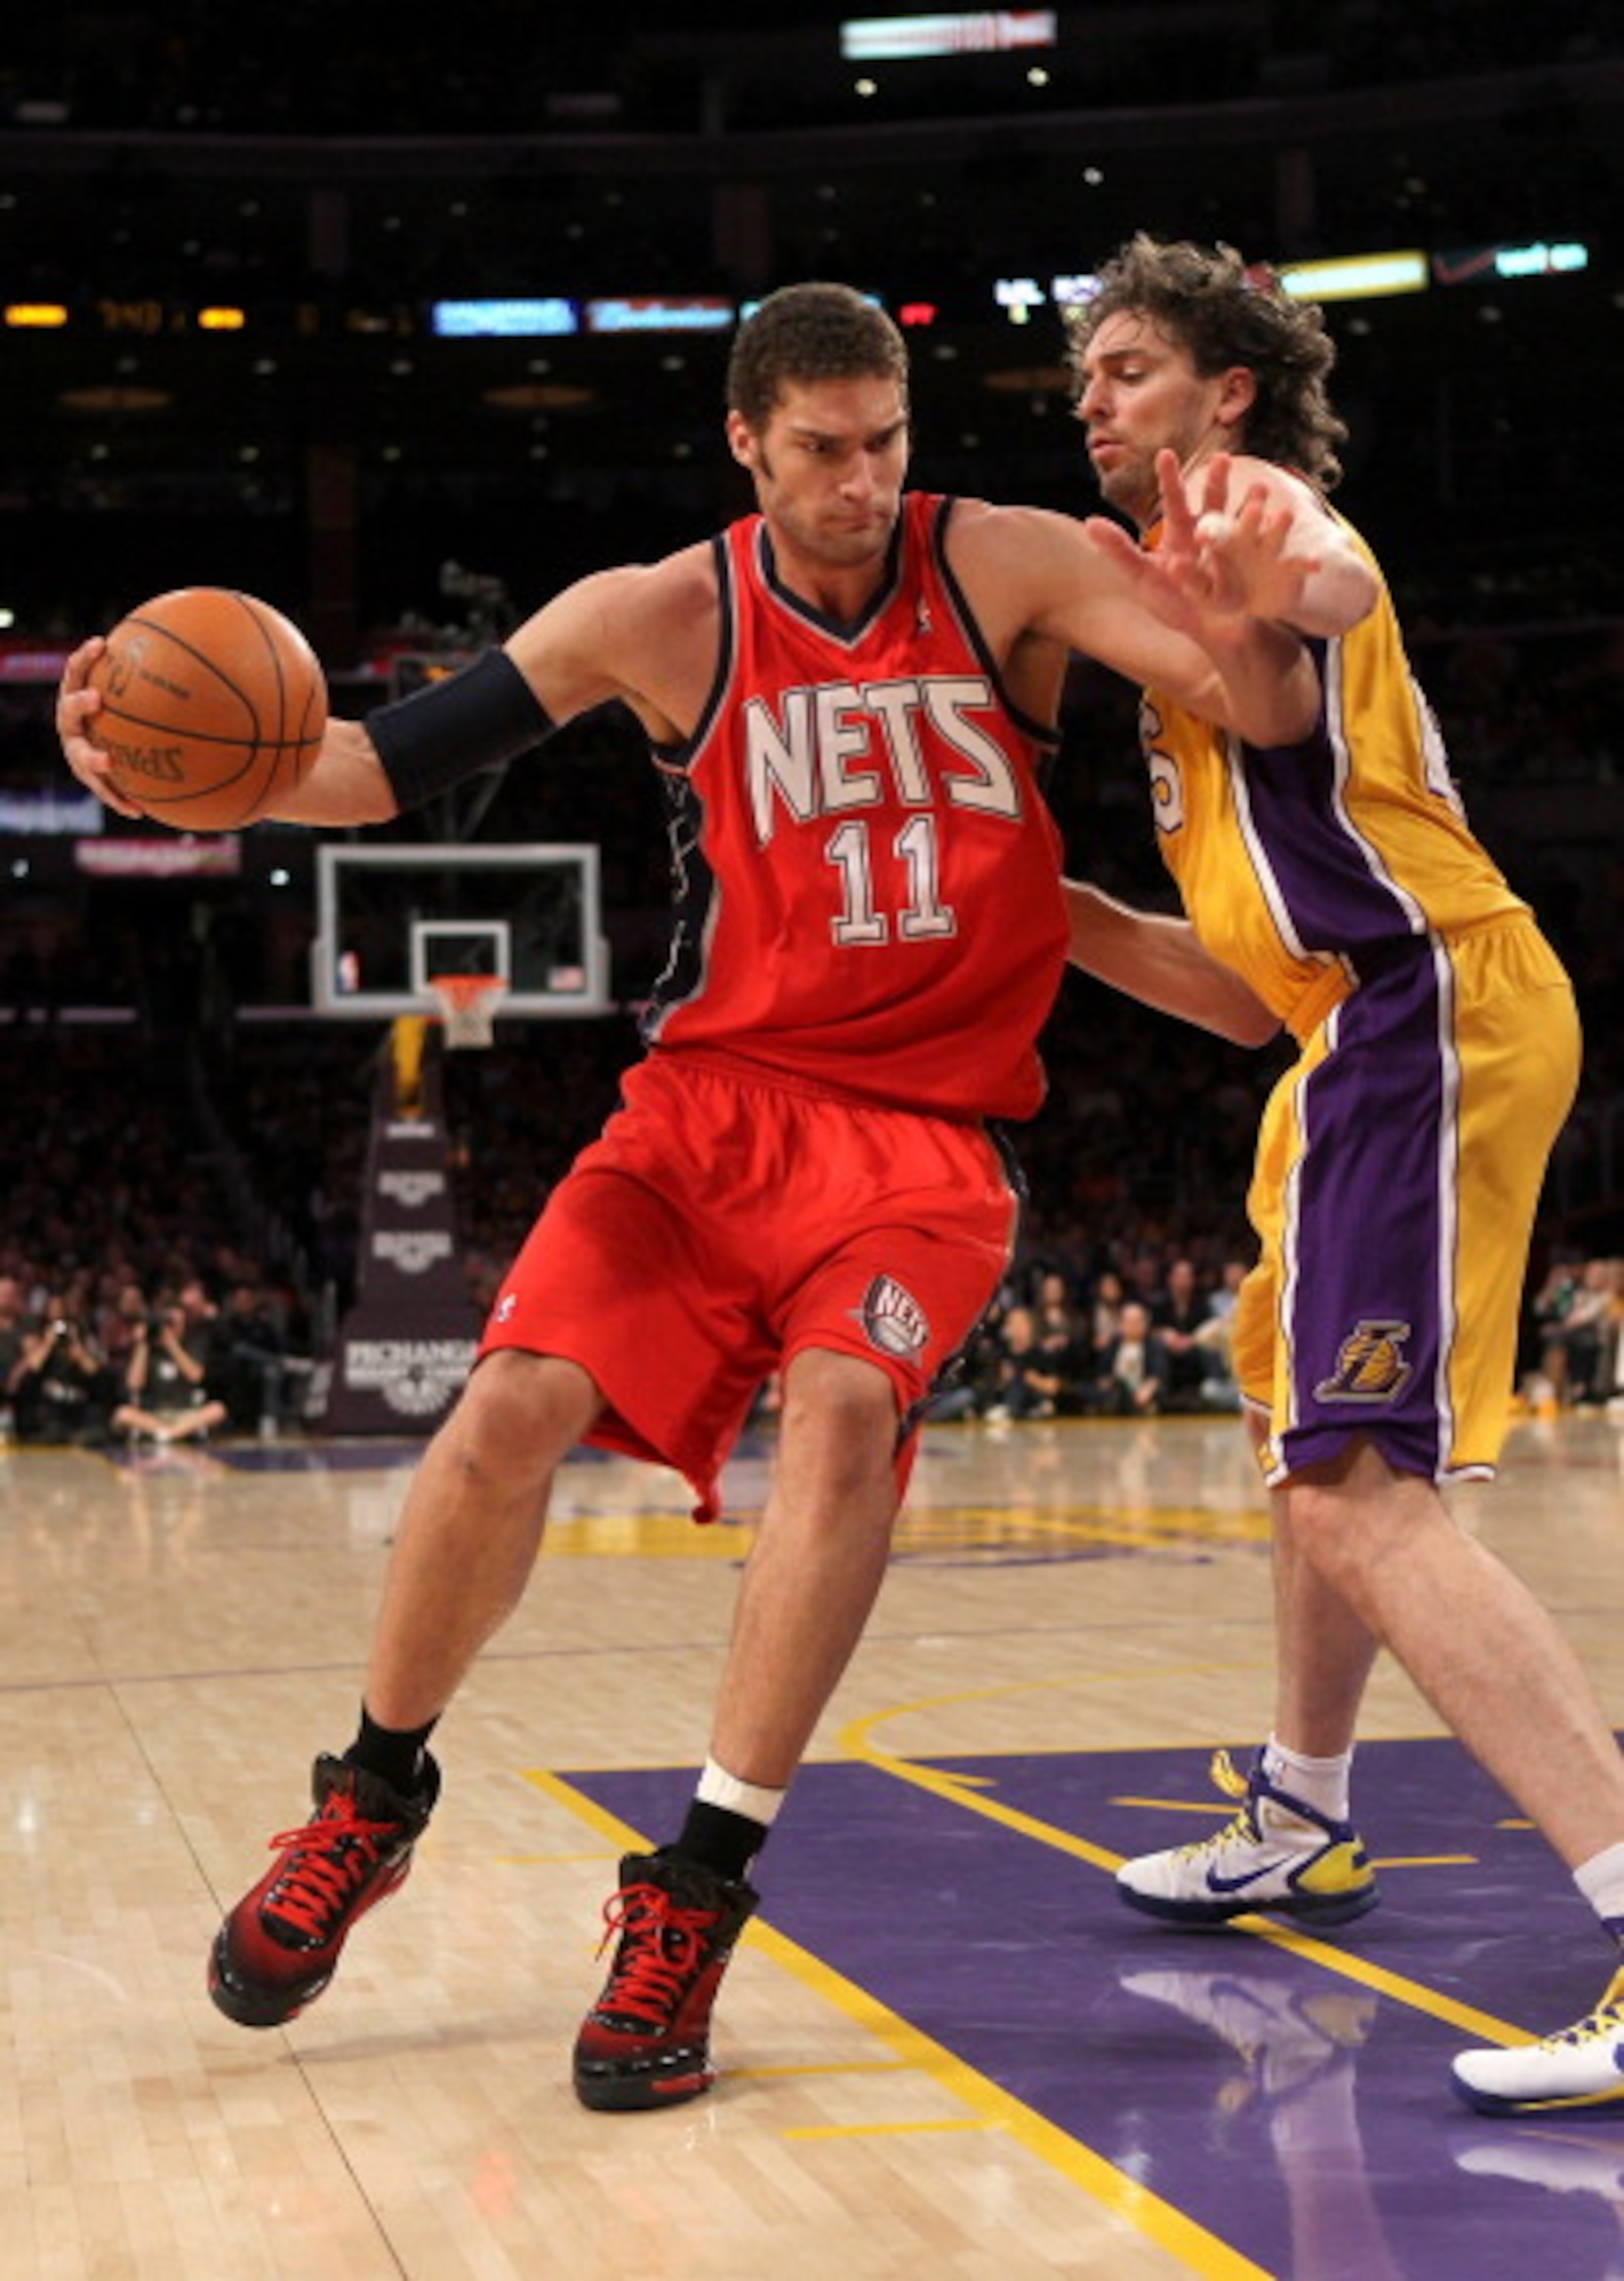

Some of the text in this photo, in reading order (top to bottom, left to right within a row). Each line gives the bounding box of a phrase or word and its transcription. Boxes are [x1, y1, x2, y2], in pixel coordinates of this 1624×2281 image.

[744, 675, 1021, 850] NETS
[825, 813, 956, 946] 11
[873, 1282, 927, 1347] NETS
